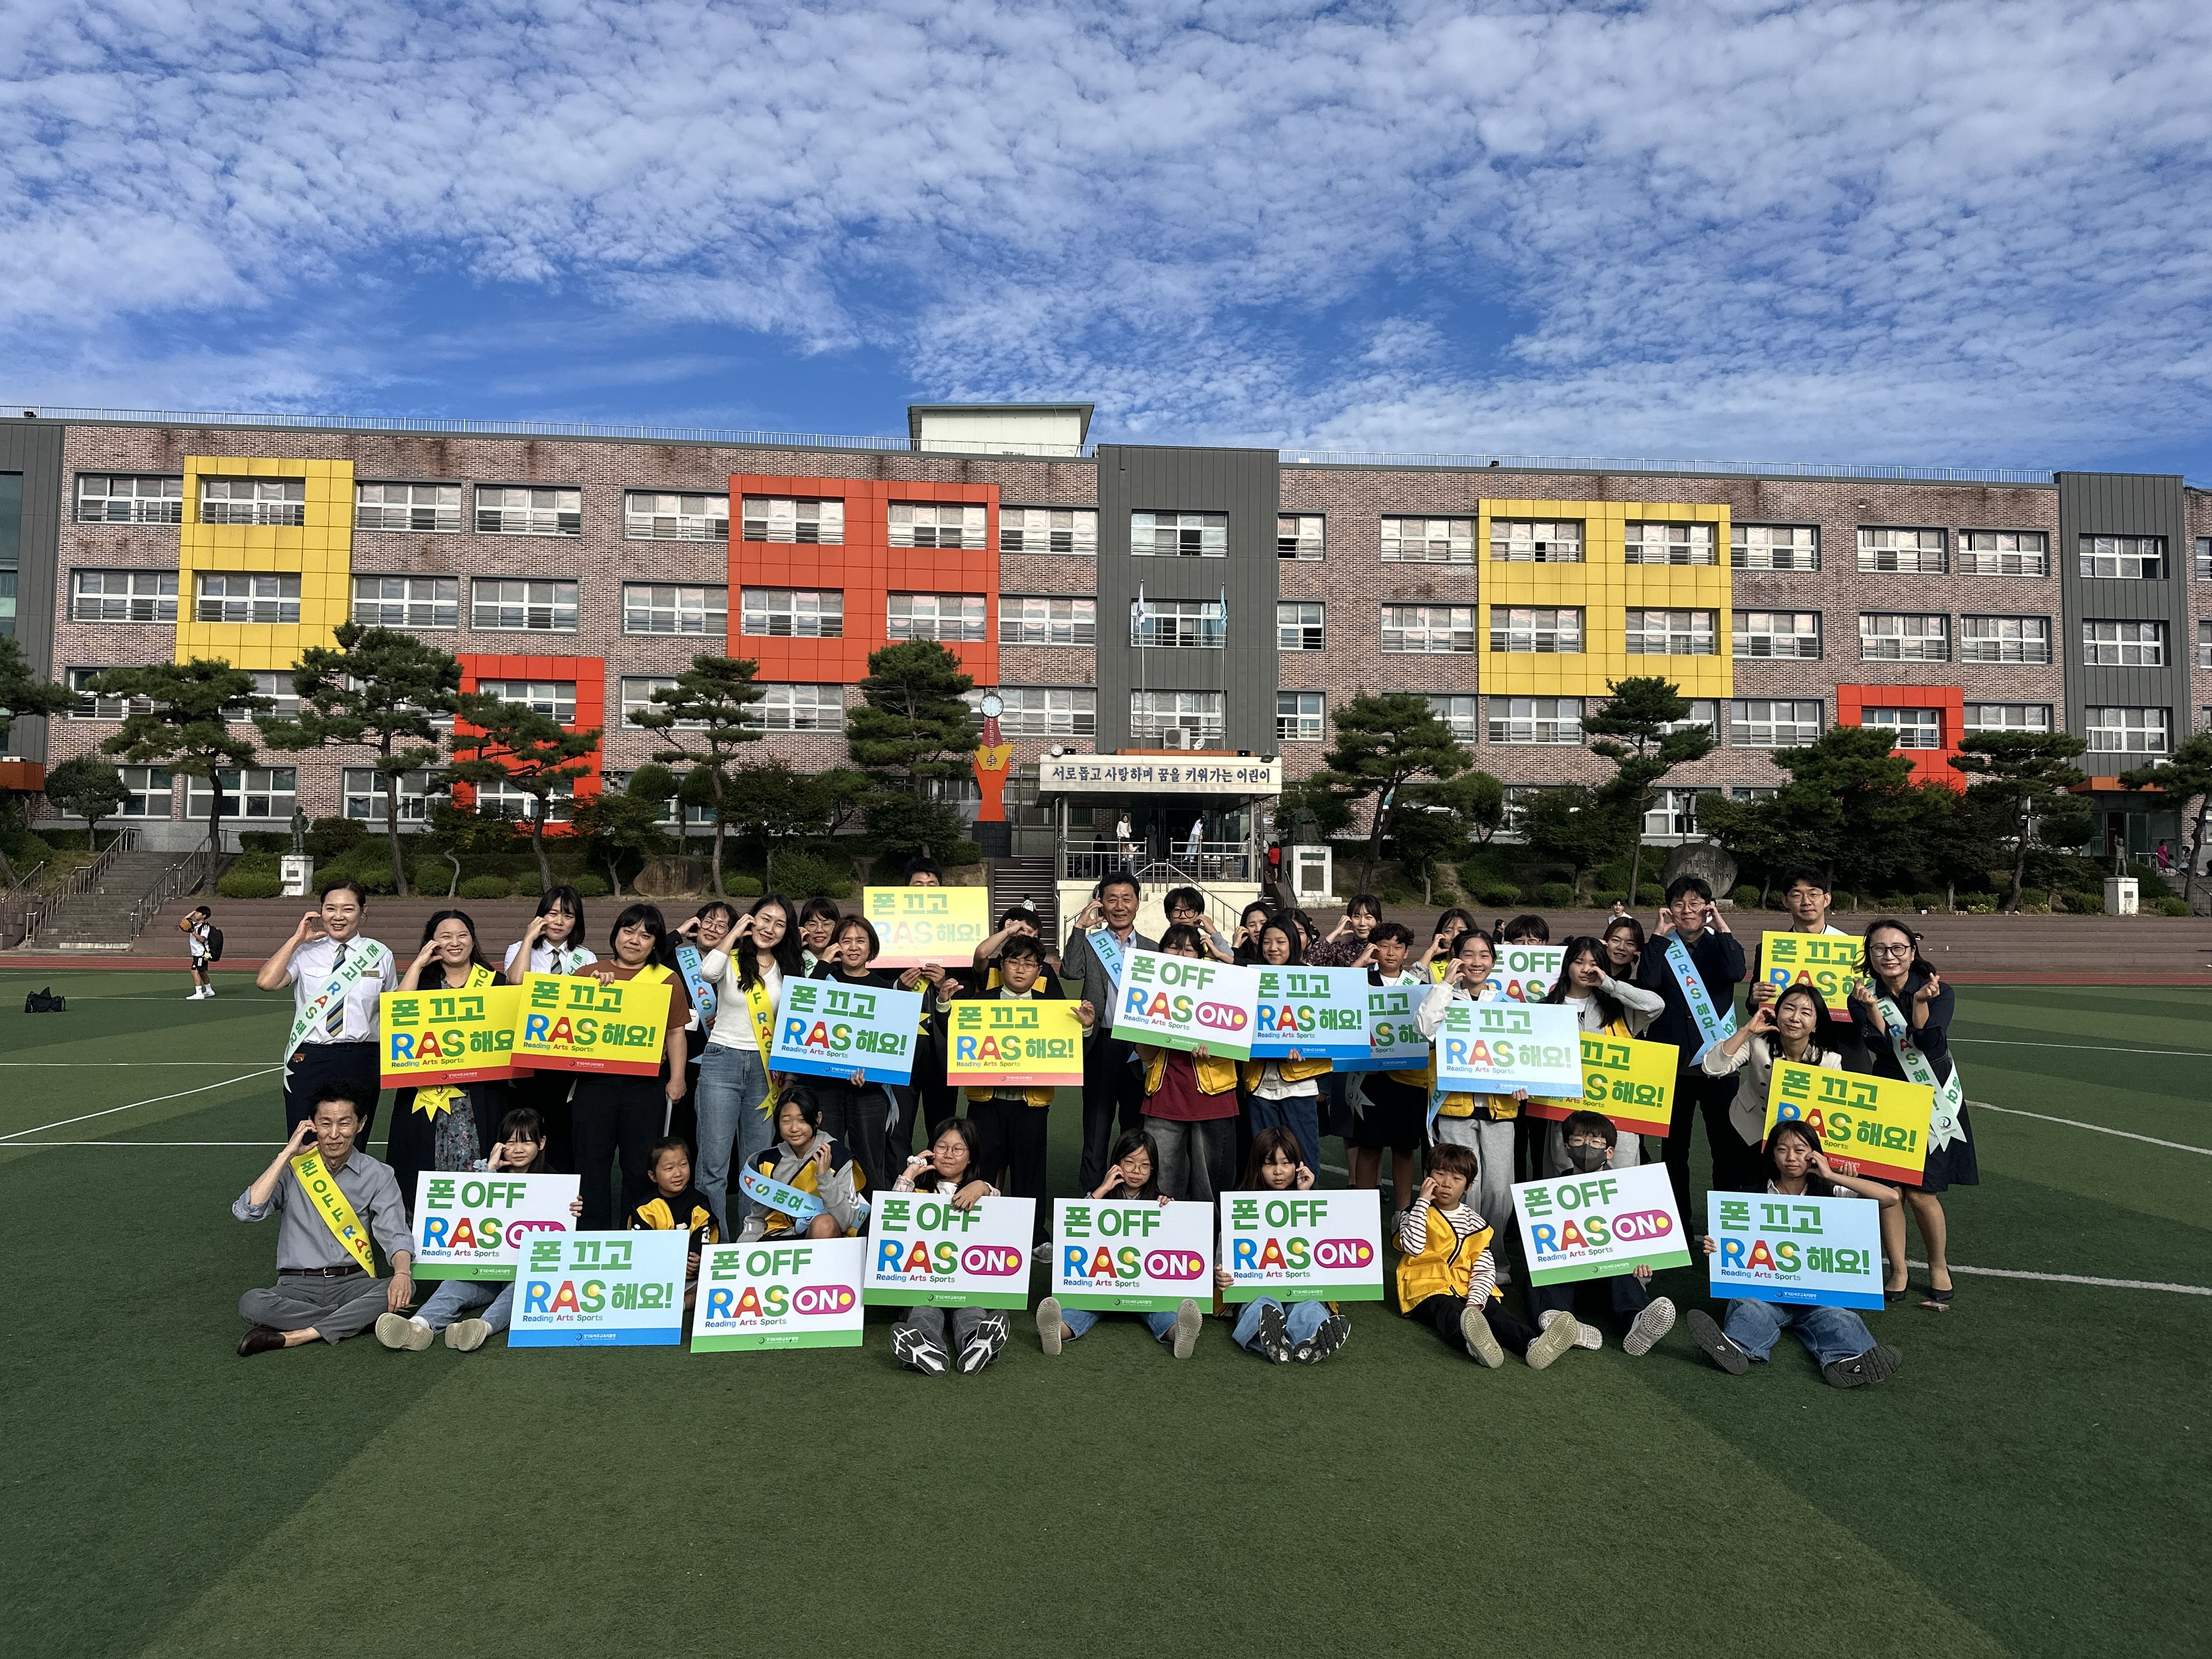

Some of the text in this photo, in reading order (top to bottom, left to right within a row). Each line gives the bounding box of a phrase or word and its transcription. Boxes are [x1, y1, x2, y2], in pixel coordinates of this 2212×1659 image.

[1105, 766, 1153, 782] 사랑하며
[1158, 768, 1180, 782] 꿈을
[1237, 768, 1271, 783] 어린이
[873, 894, 949, 915] 폰 끄고
[872, 921, 980, 944] RAS 해요!
[366, 943, 379, 958] 폰
[1509, 952, 1561, 973] OFF
[1771, 939, 1858, 966] 폰 끄고
[341, 956, 368, 981] 끄고
[1131, 955, 1155, 983] 폰
[1160, 962, 1216, 990] OFF
[1770, 968, 1837, 996] RAS
[306, 981, 341, 1019] RAS
[531, 981, 623, 1013] 폰 끄고
[691, 974, 712, 1010] RAS
[1259, 973, 1330, 998] 폰 끄고
[391, 996, 486, 1026] 폰 끄고
[790, 985, 817, 1013] 폰
[822, 990, 876, 1020] 끄고
[957, 1007, 1039, 1029] 폰 끄고
[1125, 986, 1234, 1027] RAS ON
[1257, 1005, 1362, 1031] RAS 해요!
[1678, 964, 1717, 1041] RAS 해요!
[524, 1014, 656, 1047] RAS 해요!
[1124, 1014, 1190, 1030] Reading Arts Sports
[1445, 1007, 1532, 1034] 폰 끄고
[391, 1029, 465, 1060] RAS
[523, 1042, 550, 1050] Reading
[781, 1045, 807, 1054] Reading
[783, 1017, 907, 1056] RAS 해요!
[957, 1035, 1074, 1060] RAS 해요!
[1889, 1023, 1919, 1065] RAS
[1446, 1038, 1571, 1068] RAS 해요!
[1580, 1040, 1630, 1071] 끄고
[1583, 1099, 1605, 1108] Sports
[1612, 1080, 1664, 1108] 해요!
[1782, 1069, 1811, 1099] 폰
[1818, 1076, 1878, 1111] 끄고
[1776, 1102, 1917, 1153] RAS 해요!
[1824, 1139, 1848, 1149] Sports
[427, 1179, 527, 1209] 폰 OFF
[742, 1172, 816, 1211] AS 해요!
[1523, 1178, 1618, 1217] 폰 OFF
[301, 1159, 374, 1265] 폰 OFF RAS
[881, 1199, 982, 1232] 폰 OFF
[1064, 1206, 1161, 1237] 폰 OFF
[1232, 1199, 1328, 1230] 폰 OFF
[1720, 1200, 1823, 1234] 폰 끄고
[422, 1217, 503, 1249] RAS
[1531, 1214, 1657, 1254] RAS ON
[421, 1249, 452, 1257] Reading
[474, 1250, 500, 1258] Sports
[530, 1240, 633, 1272] 폰 끄고
[710, 1248, 812, 1280] 폰 OFF
[877, 1239, 1006, 1274] RAS ON
[1064, 1245, 1188, 1279] RAS ON
[1233, 1237, 1357, 1269] RAS ON
[1537, 1252, 1567, 1262] Reading
[1589, 1246, 1613, 1256] Sports
[1720, 1237, 1870, 1275] RAS 해요!
[876, 1273, 906, 1282] Reading
[929, 1275, 955, 1283] Sports
[1063, 1279, 1092, 1288] Reading
[1115, 1280, 1140, 1288] Sports
[1721, 1269, 1751, 1278] Reading
[1775, 1273, 1801, 1282] Sports
[524, 1279, 673, 1313] RAS 해요!
[706, 1285, 838, 1319] RAS ON
[523, 1314, 554, 1323] Reading
[577, 1314, 603, 1323] Sports
[760, 1318, 787, 1326] Sports
